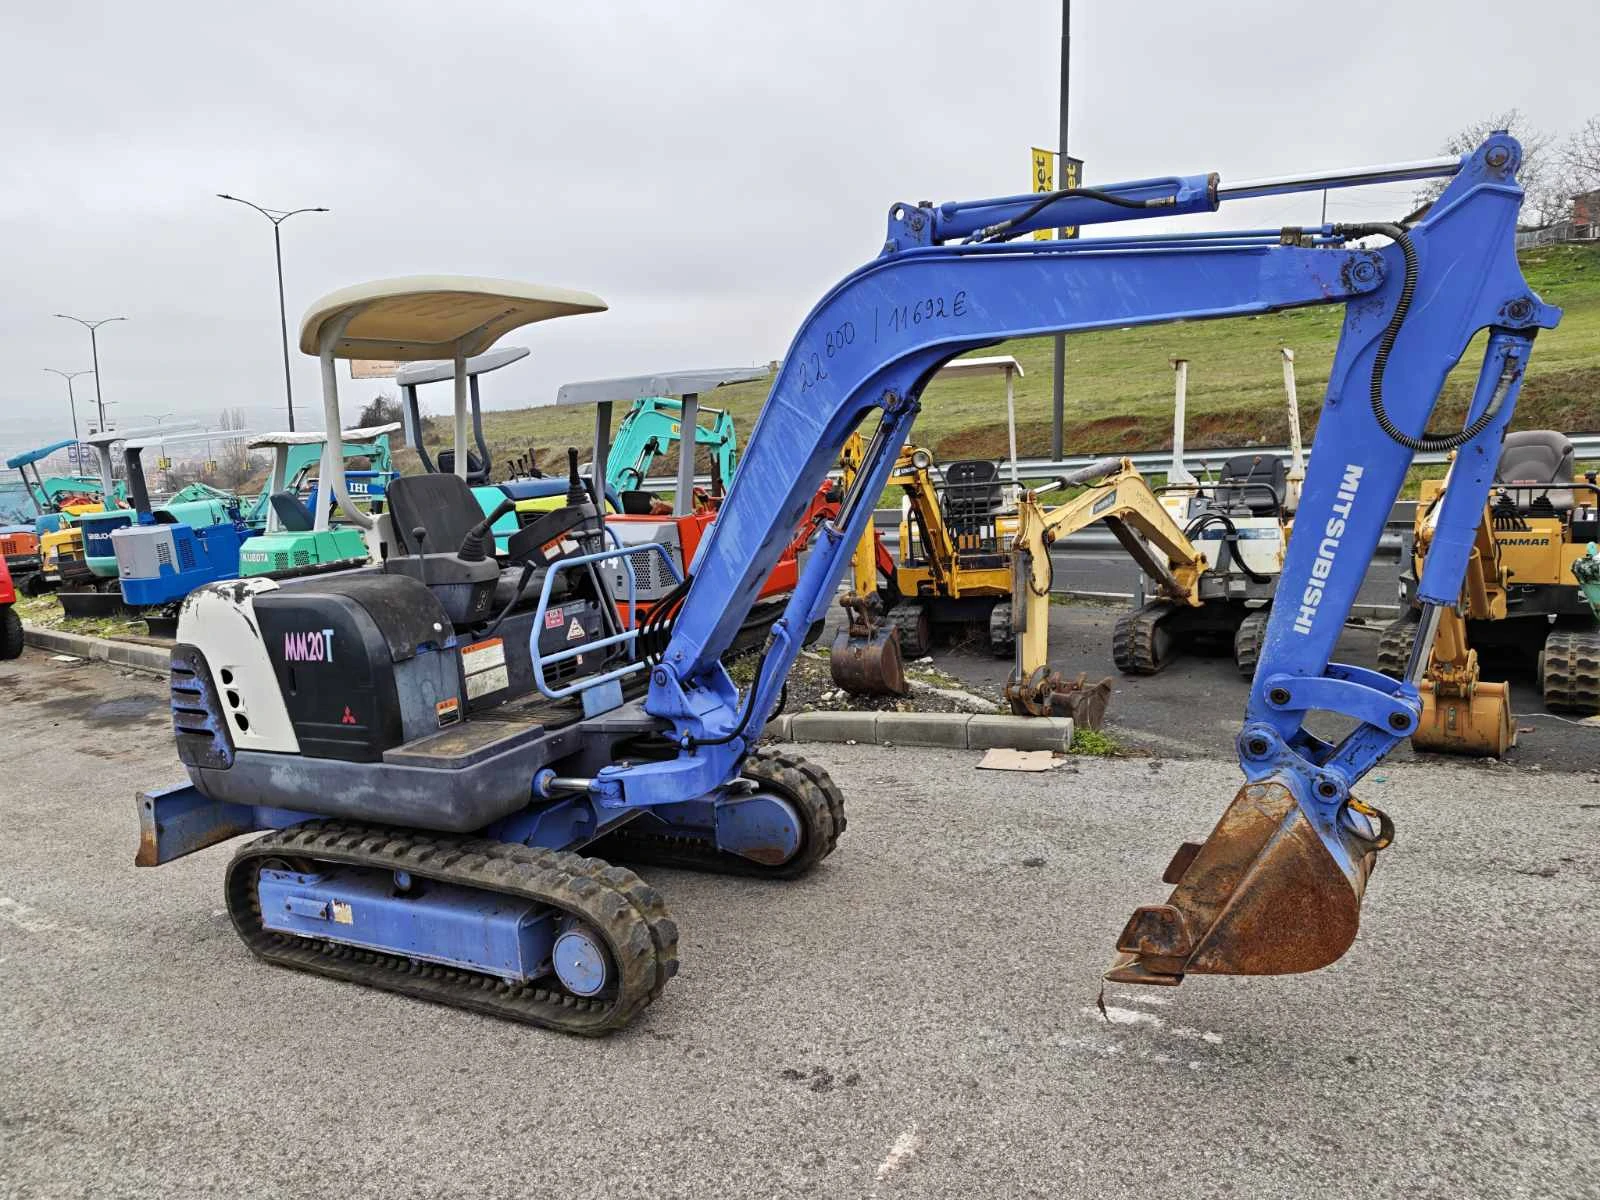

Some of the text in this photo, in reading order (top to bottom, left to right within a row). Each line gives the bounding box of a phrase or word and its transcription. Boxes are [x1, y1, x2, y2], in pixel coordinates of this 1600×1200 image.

[349, 482, 369, 493] IHI
[1292, 464, 1365, 635] MITSUBISHI
[285, 628, 335, 663] MM20T
